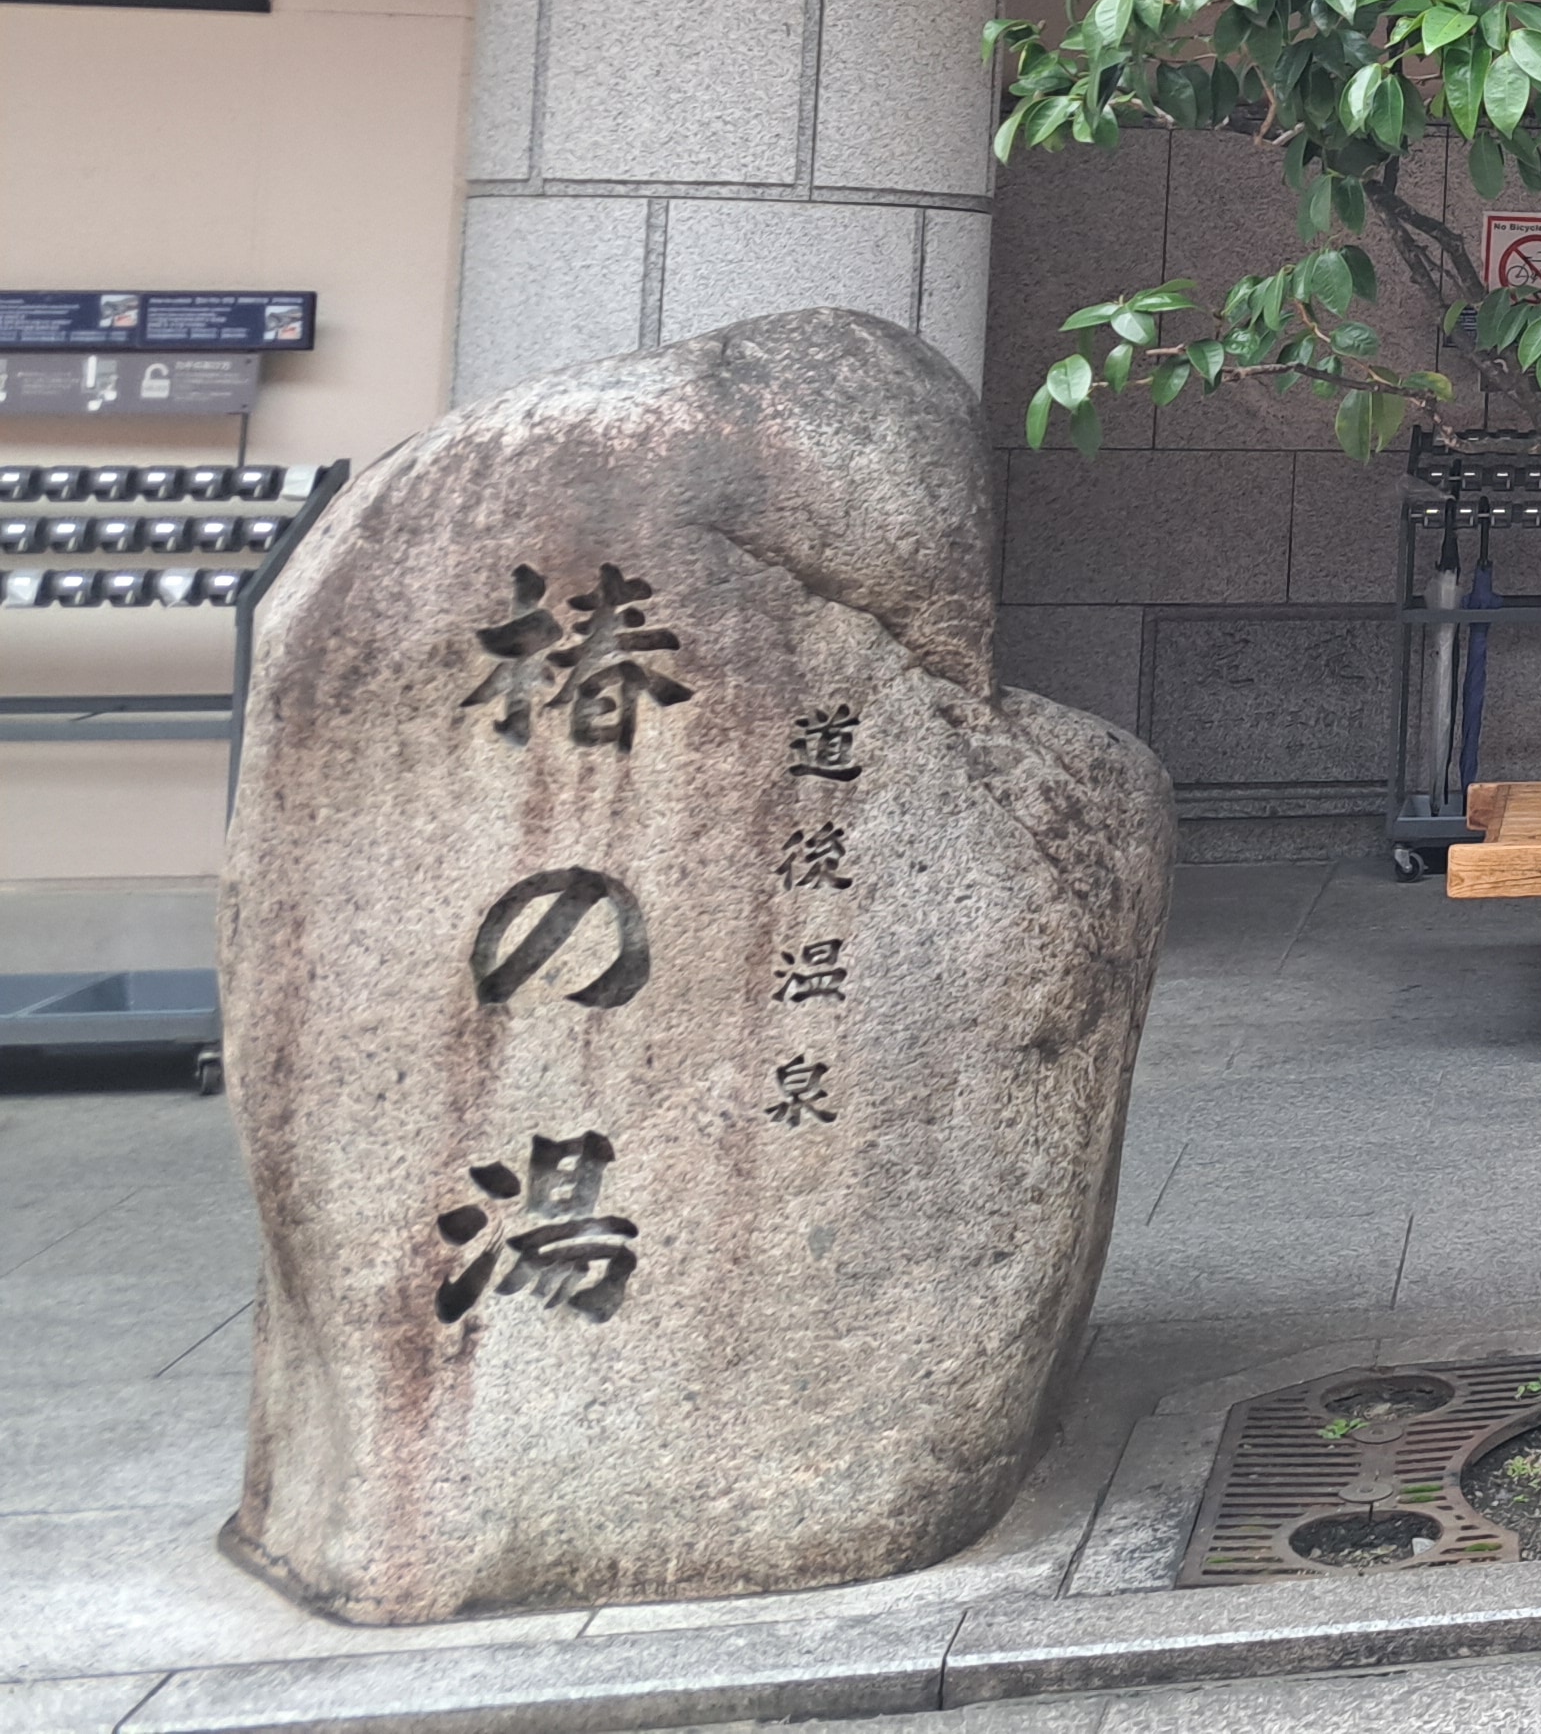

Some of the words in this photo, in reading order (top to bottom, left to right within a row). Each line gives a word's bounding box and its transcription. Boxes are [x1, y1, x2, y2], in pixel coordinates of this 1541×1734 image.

[432, 562, 694, 1325] 椿の湯
[764, 703, 864, 1128] 道後温泉
